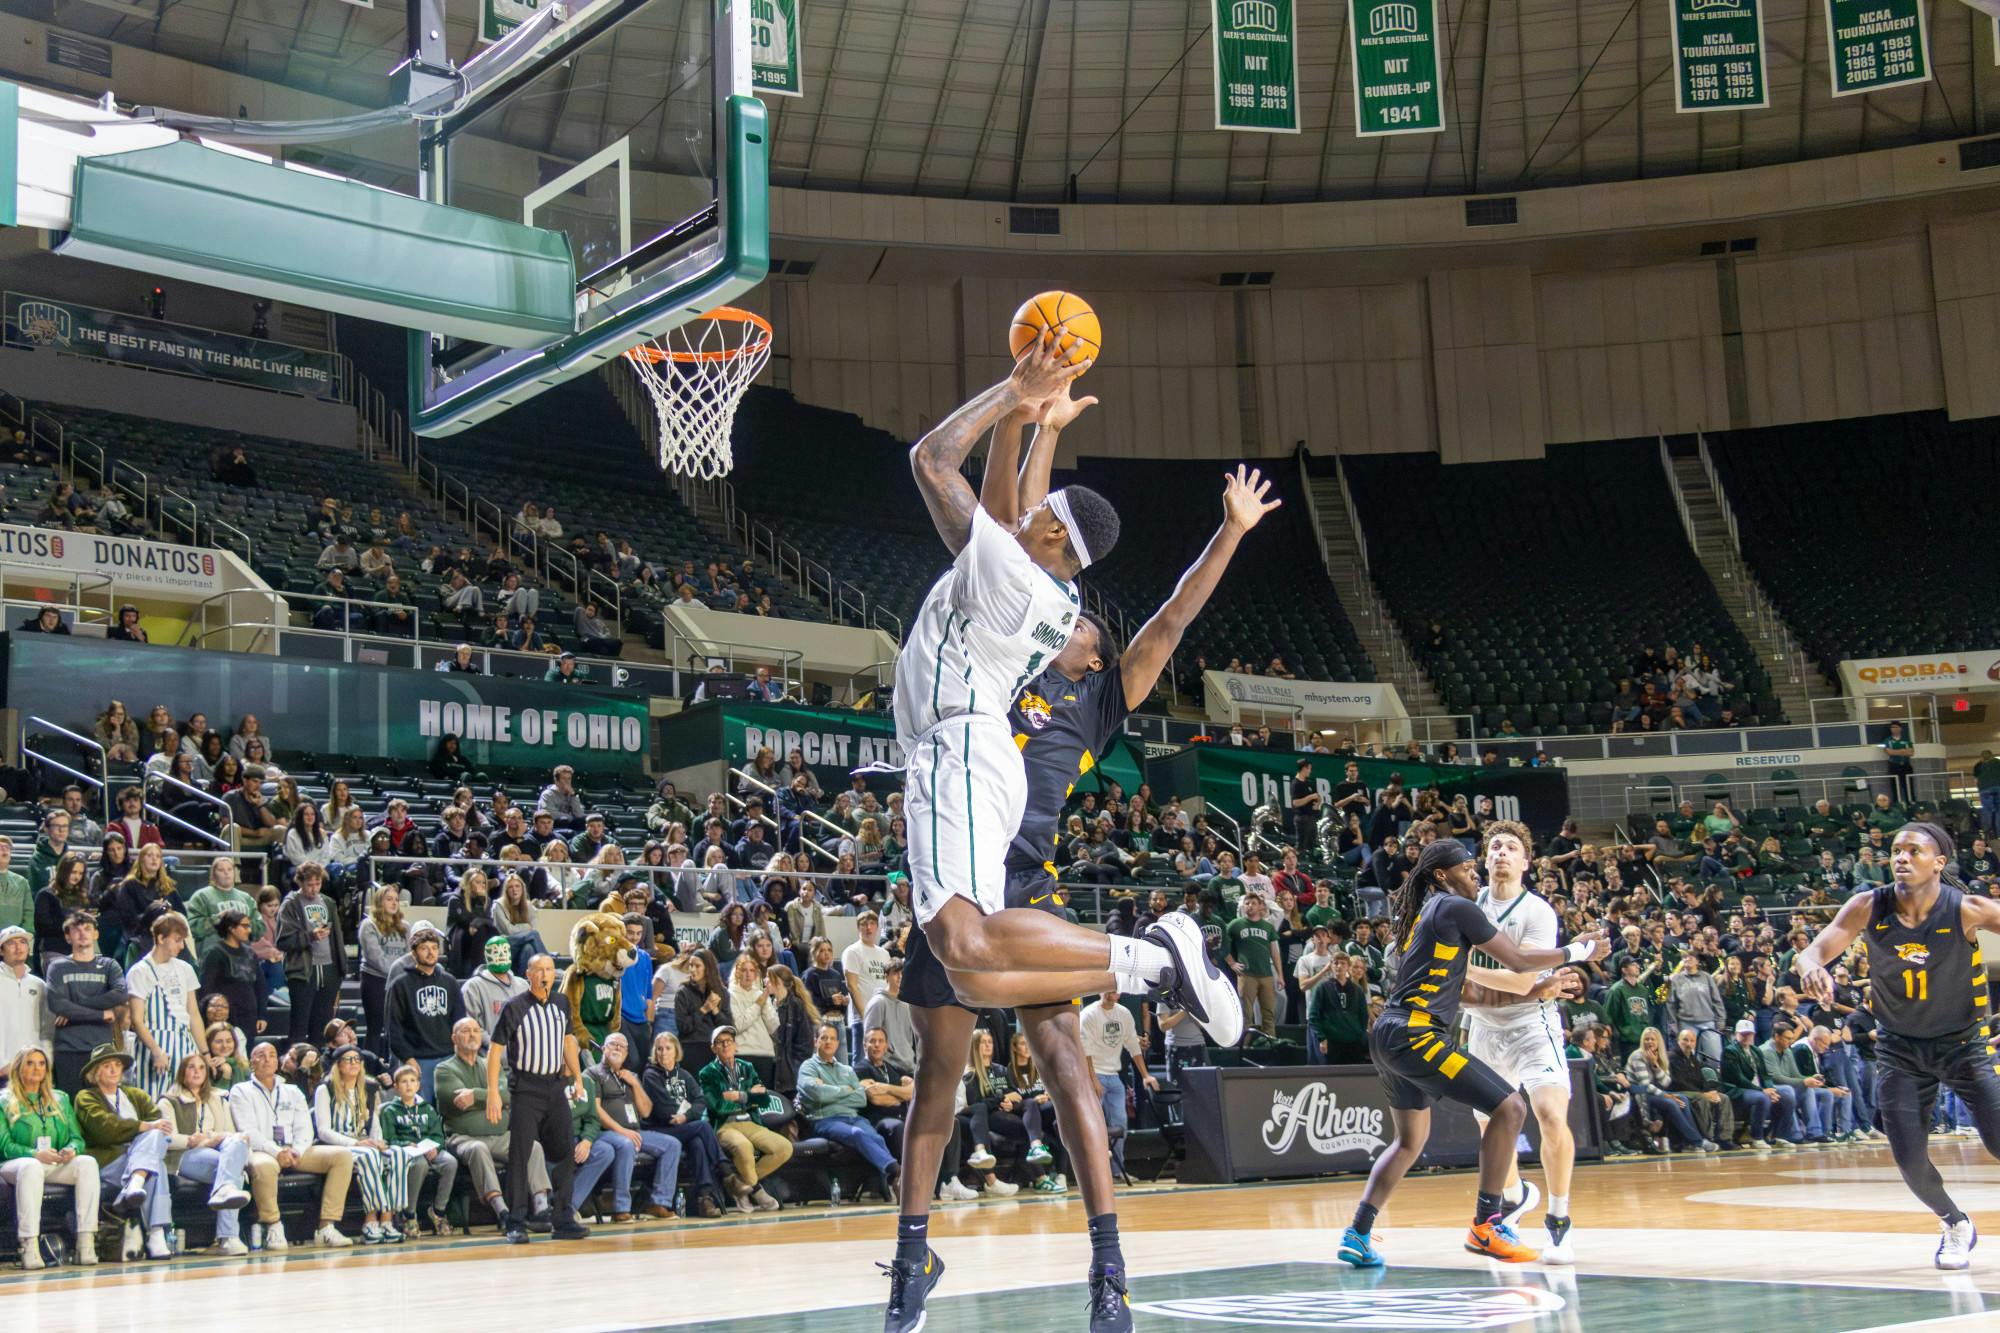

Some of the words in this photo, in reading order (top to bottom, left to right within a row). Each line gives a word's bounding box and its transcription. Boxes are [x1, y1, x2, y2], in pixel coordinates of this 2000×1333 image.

[1232, 1, 1278, 32] OHIO
[1370, 3, 1417, 36] OHIO
[1707, 9, 1752, 20] BASKETBALL
[1859, 9, 1892, 25] NCAA
[1837, 16, 1915, 40] TOURNAMENT
[1223, 31, 1247, 41] MEN'S
[1247, 32, 1288, 43] BASKETBALL
[1361, 37, 1384, 46] MEN'S
[1386, 34, 1429, 45] BASKETBALL
[1703, 33, 1734, 45] NCAA
[1682, 43, 1756, 58] TOURNAMENT
[1844, 42, 1875, 58] 1974
[1881, 35, 1912, 50] 1983
[1244, 56, 1269, 71] NIT
[1384, 59, 1409, 73] NIT
[1723, 61, 1752, 73] 1961
[1846, 55, 1876, 70] 1985
[1882, 48, 1913, 64] 1994
[1689, 77, 1718, 88] 1964
[1725, 74, 1753, 86] 1965
[1847, 68, 1877, 84] 2005
[1884, 61, 1915, 77] 2010
[1261, 84, 1287, 97] 1986
[1364, 81, 1431, 98] RUNNER-UP
[1690, 89, 1719, 101] 1970
[1726, 87, 1754, 99] 1972
[1261, 97, 1287, 110] 2013
[1379, 105, 1421, 124] 1941
[78, 327, 107, 343] THE
[109, 332, 148, 351] BEST
[149, 339, 185, 358] FANS
[189, 347, 203, 360] IN
[206, 350, 231, 366] THE
[233, 354, 261, 371] MAC
[263, 359, 292, 376] LIVE
[294, 366, 328, 383] HERE
[94, 540, 200, 575] DONATOS
[126, 572, 152, 582] piece
[166, 575, 213, 589] important
[1858, 661, 1956, 684] QDOBA
[1304, 692, 1371, 705] mhsystem.org
[419, 699, 512, 743] HOME
[521, 708, 558, 745] OF
[567, 712, 641, 752] OHIO
[745, 726, 851, 767] BOBCAT
[1736, 754, 1801, 766] RESERVED
[1902, 969, 1927, 1000] 11
[1273, 1089, 1294, 1107] Visit
[1262, 1081, 1383, 1155] Athens
[1320, 1139, 1350, 1151] COUNTY
[1352, 1137, 1372, 1146] OHIO
